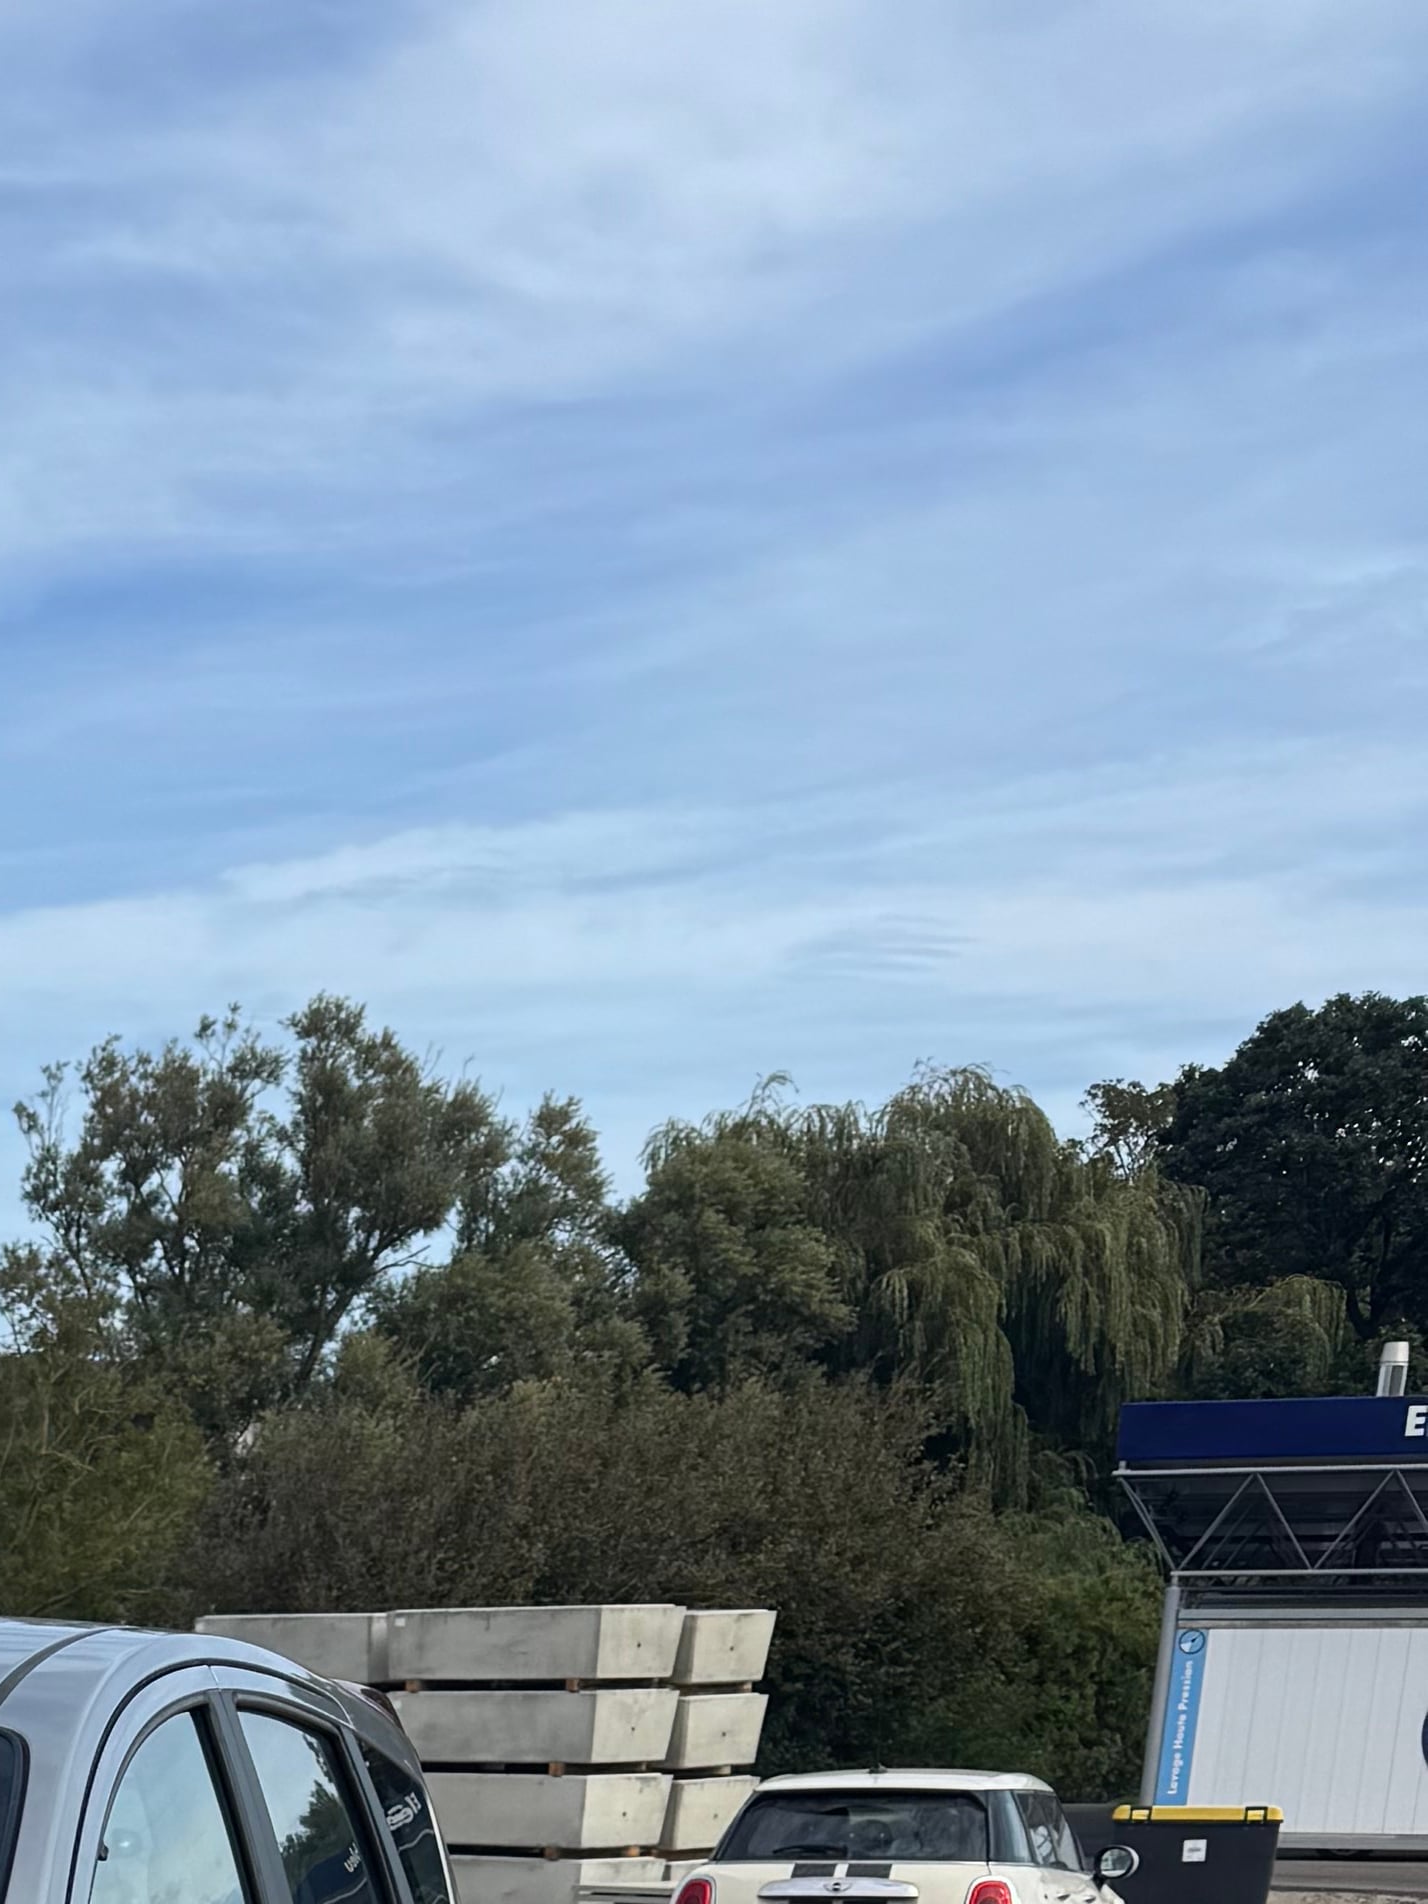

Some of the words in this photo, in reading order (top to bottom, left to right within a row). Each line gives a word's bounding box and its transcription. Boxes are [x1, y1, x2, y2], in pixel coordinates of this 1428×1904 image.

[1178, 1660, 1194, 1711] Pression
[1173, 1715, 1187, 1750] Haute
[1167, 1753, 1184, 1795] Lavage
